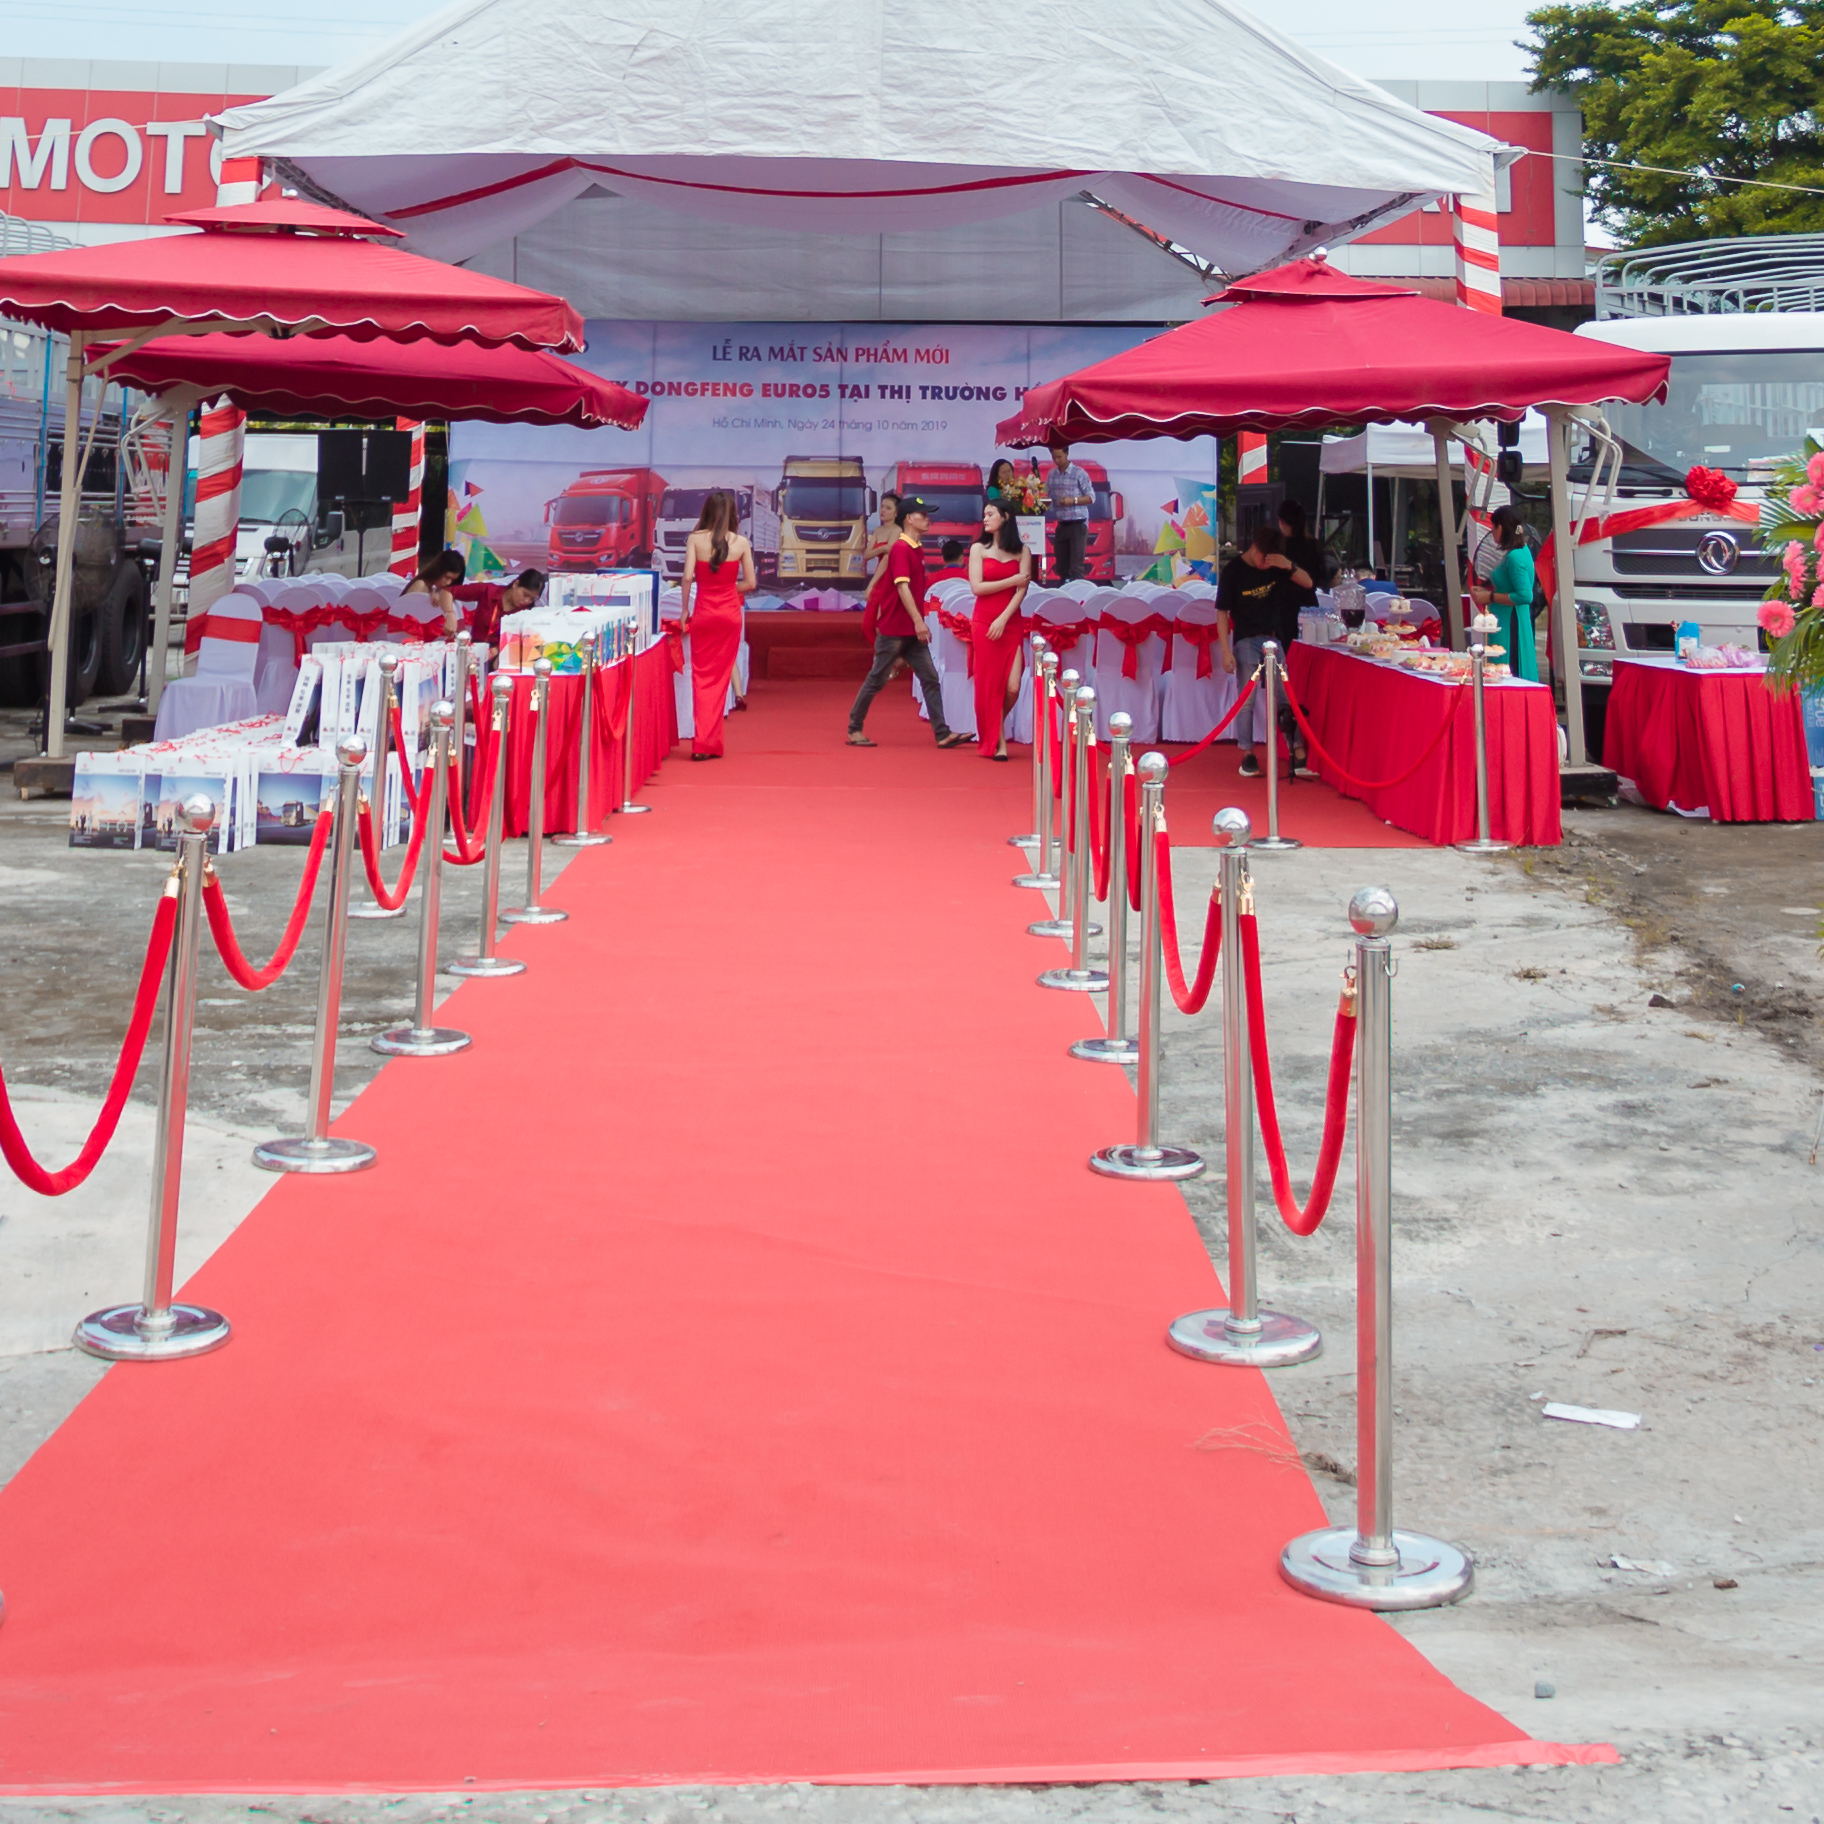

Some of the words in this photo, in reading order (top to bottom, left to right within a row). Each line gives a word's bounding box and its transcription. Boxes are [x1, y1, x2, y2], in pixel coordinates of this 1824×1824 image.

[712, 339, 732, 361] LỄ
[739, 346, 762, 362] RA
[768, 340, 807, 363] MẮT
[812, 341, 848, 363] SẢN
[854, 339, 908, 364] PHẨM
[914, 344, 950, 365] MỚI
[635, 381, 754, 398] DONGFENG
[761, 383, 831, 399] EURO5
[838, 384, 870, 403] TẠI
[877, 385, 912, 404] THỊ
[919, 382, 1008, 401] TRƯỜNG
[753, 418, 782, 431] Minh,
[788, 418, 819, 432] Ngày
[822, 419, 835, 430] 24
[838, 418, 873, 432] tháng
[876, 420, 889, 431] 10
[891, 420, 918, 431] năm
[921, 421, 948, 431] 2019
